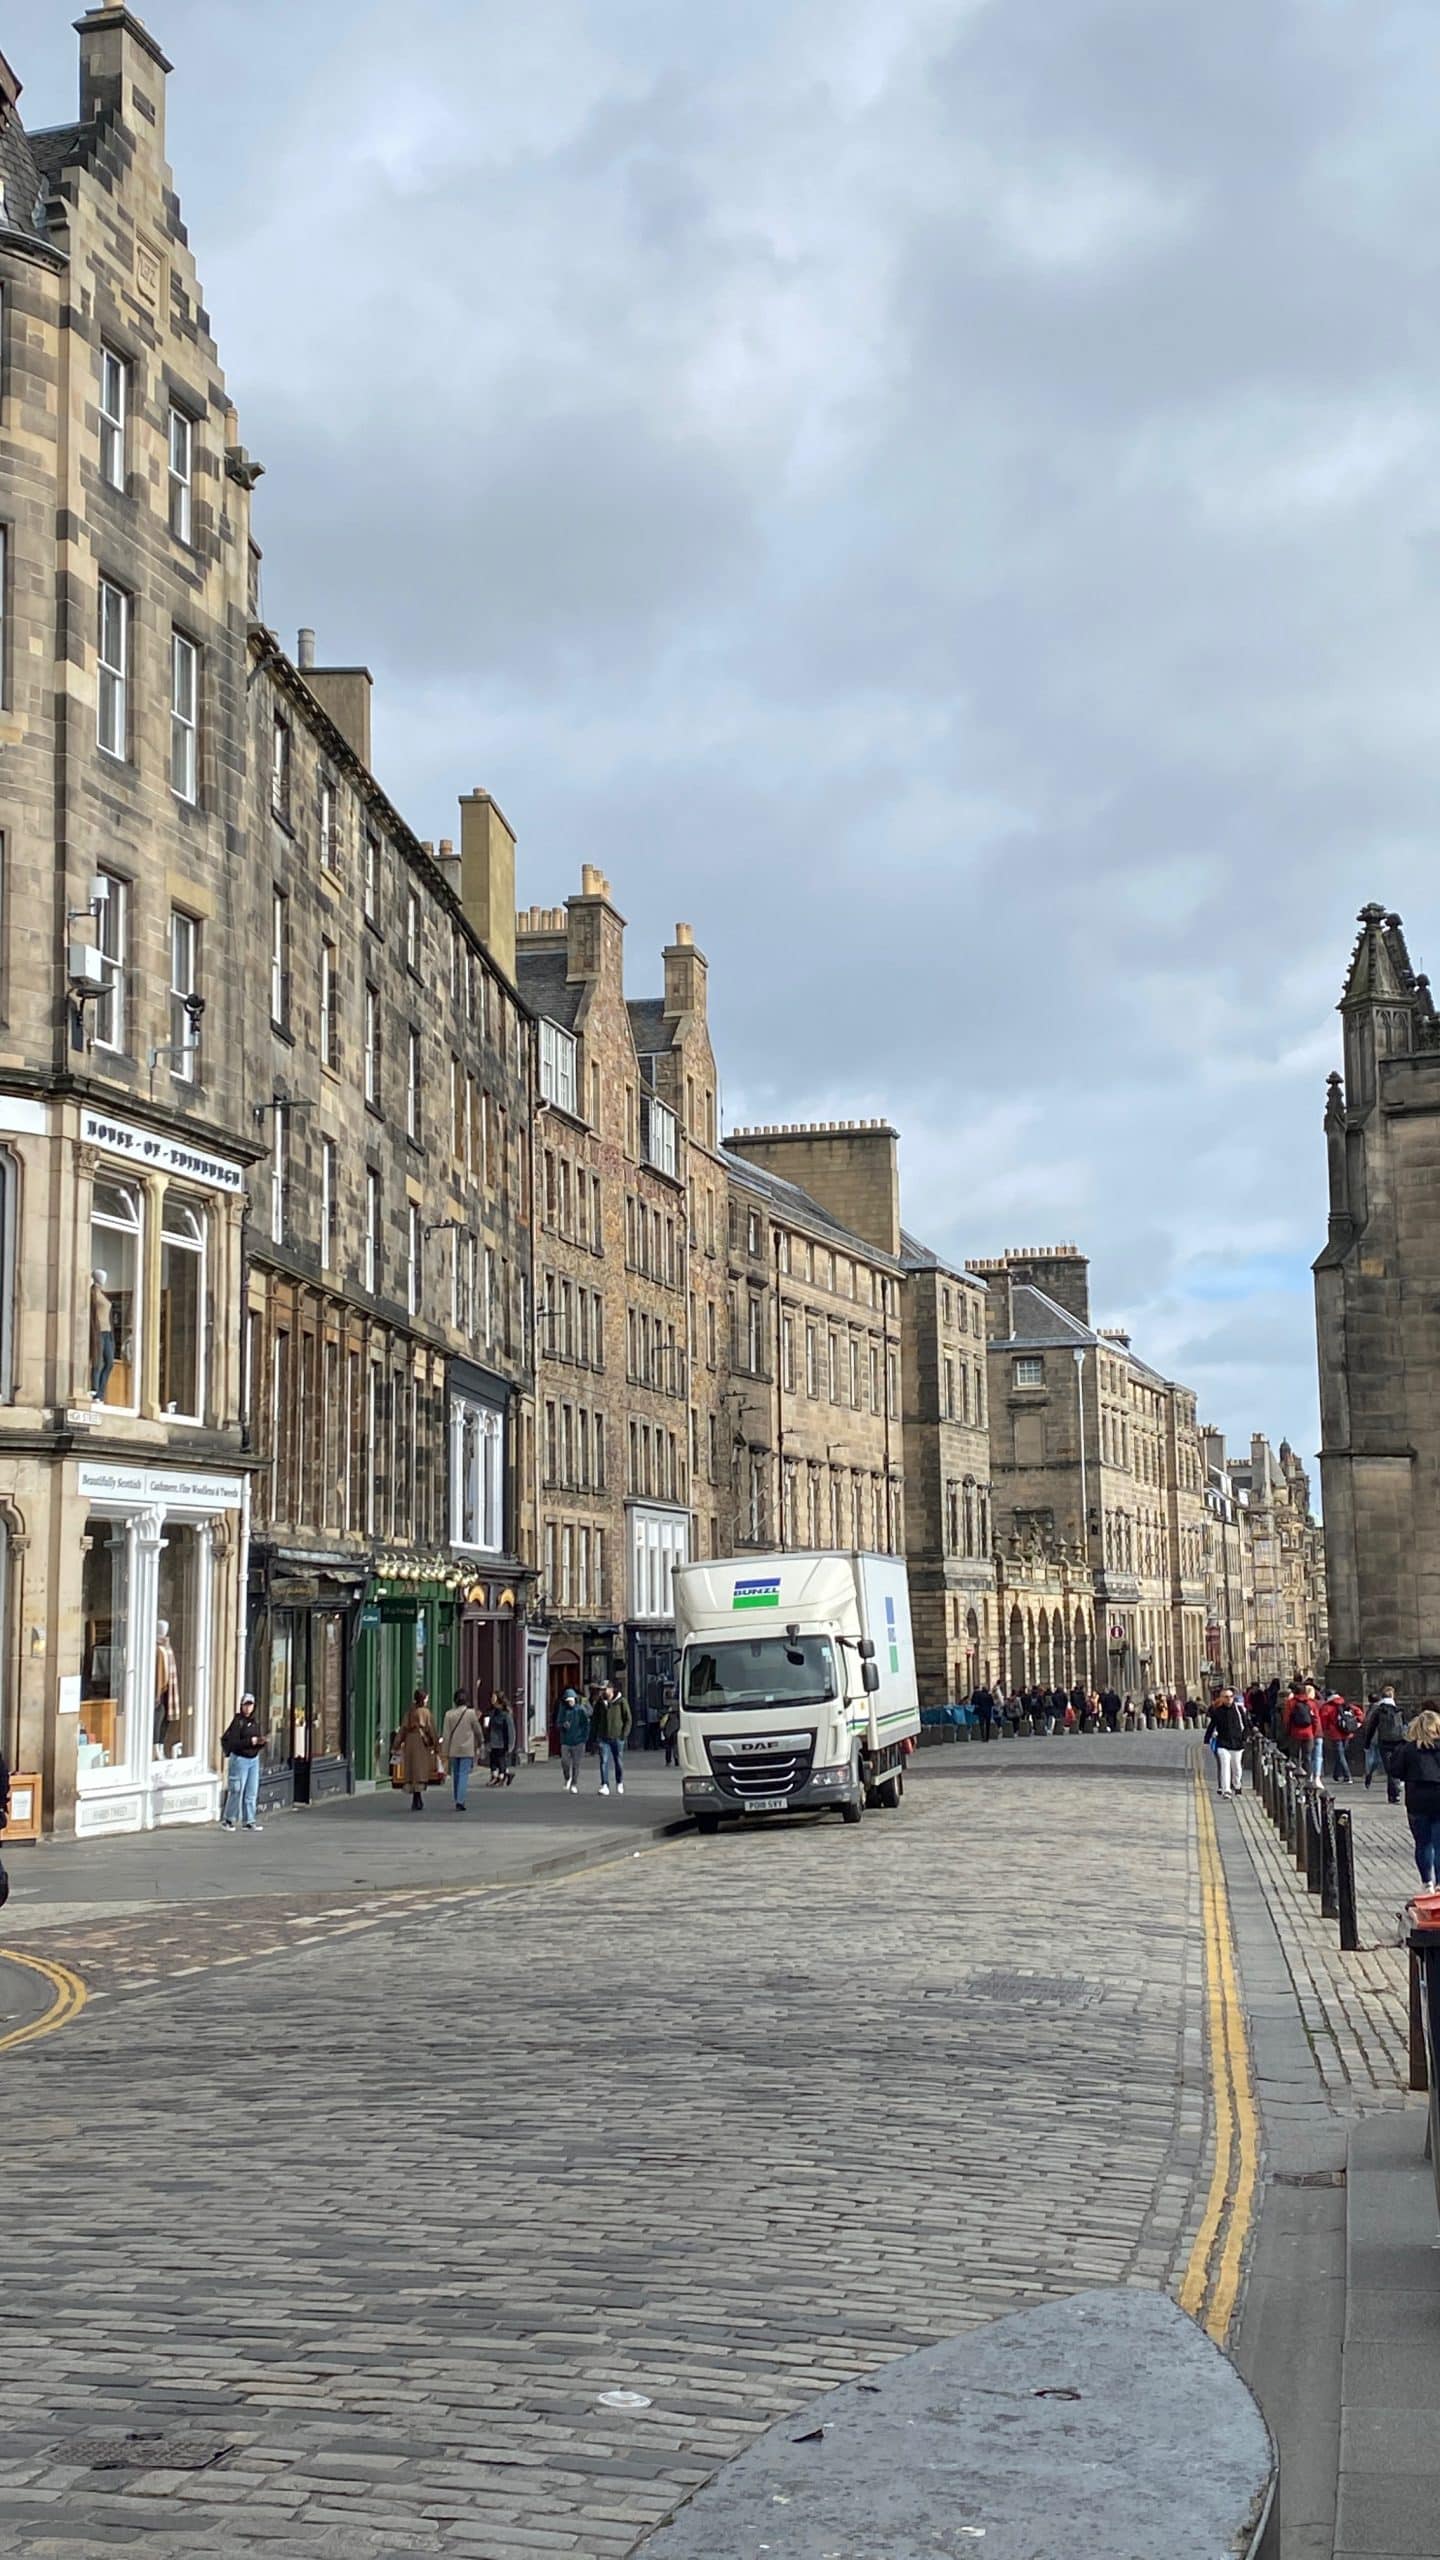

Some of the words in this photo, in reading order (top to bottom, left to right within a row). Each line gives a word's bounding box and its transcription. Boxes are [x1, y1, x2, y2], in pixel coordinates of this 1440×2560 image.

[87, 1120, 133, 1148] HOUSE
[144, 1140, 161, 1158] OF
[170, 1149, 240, 1186] EDINBURGH
[733, 1587, 780, 1597] BUNZL
[741, 1741, 779, 1751] DAF
